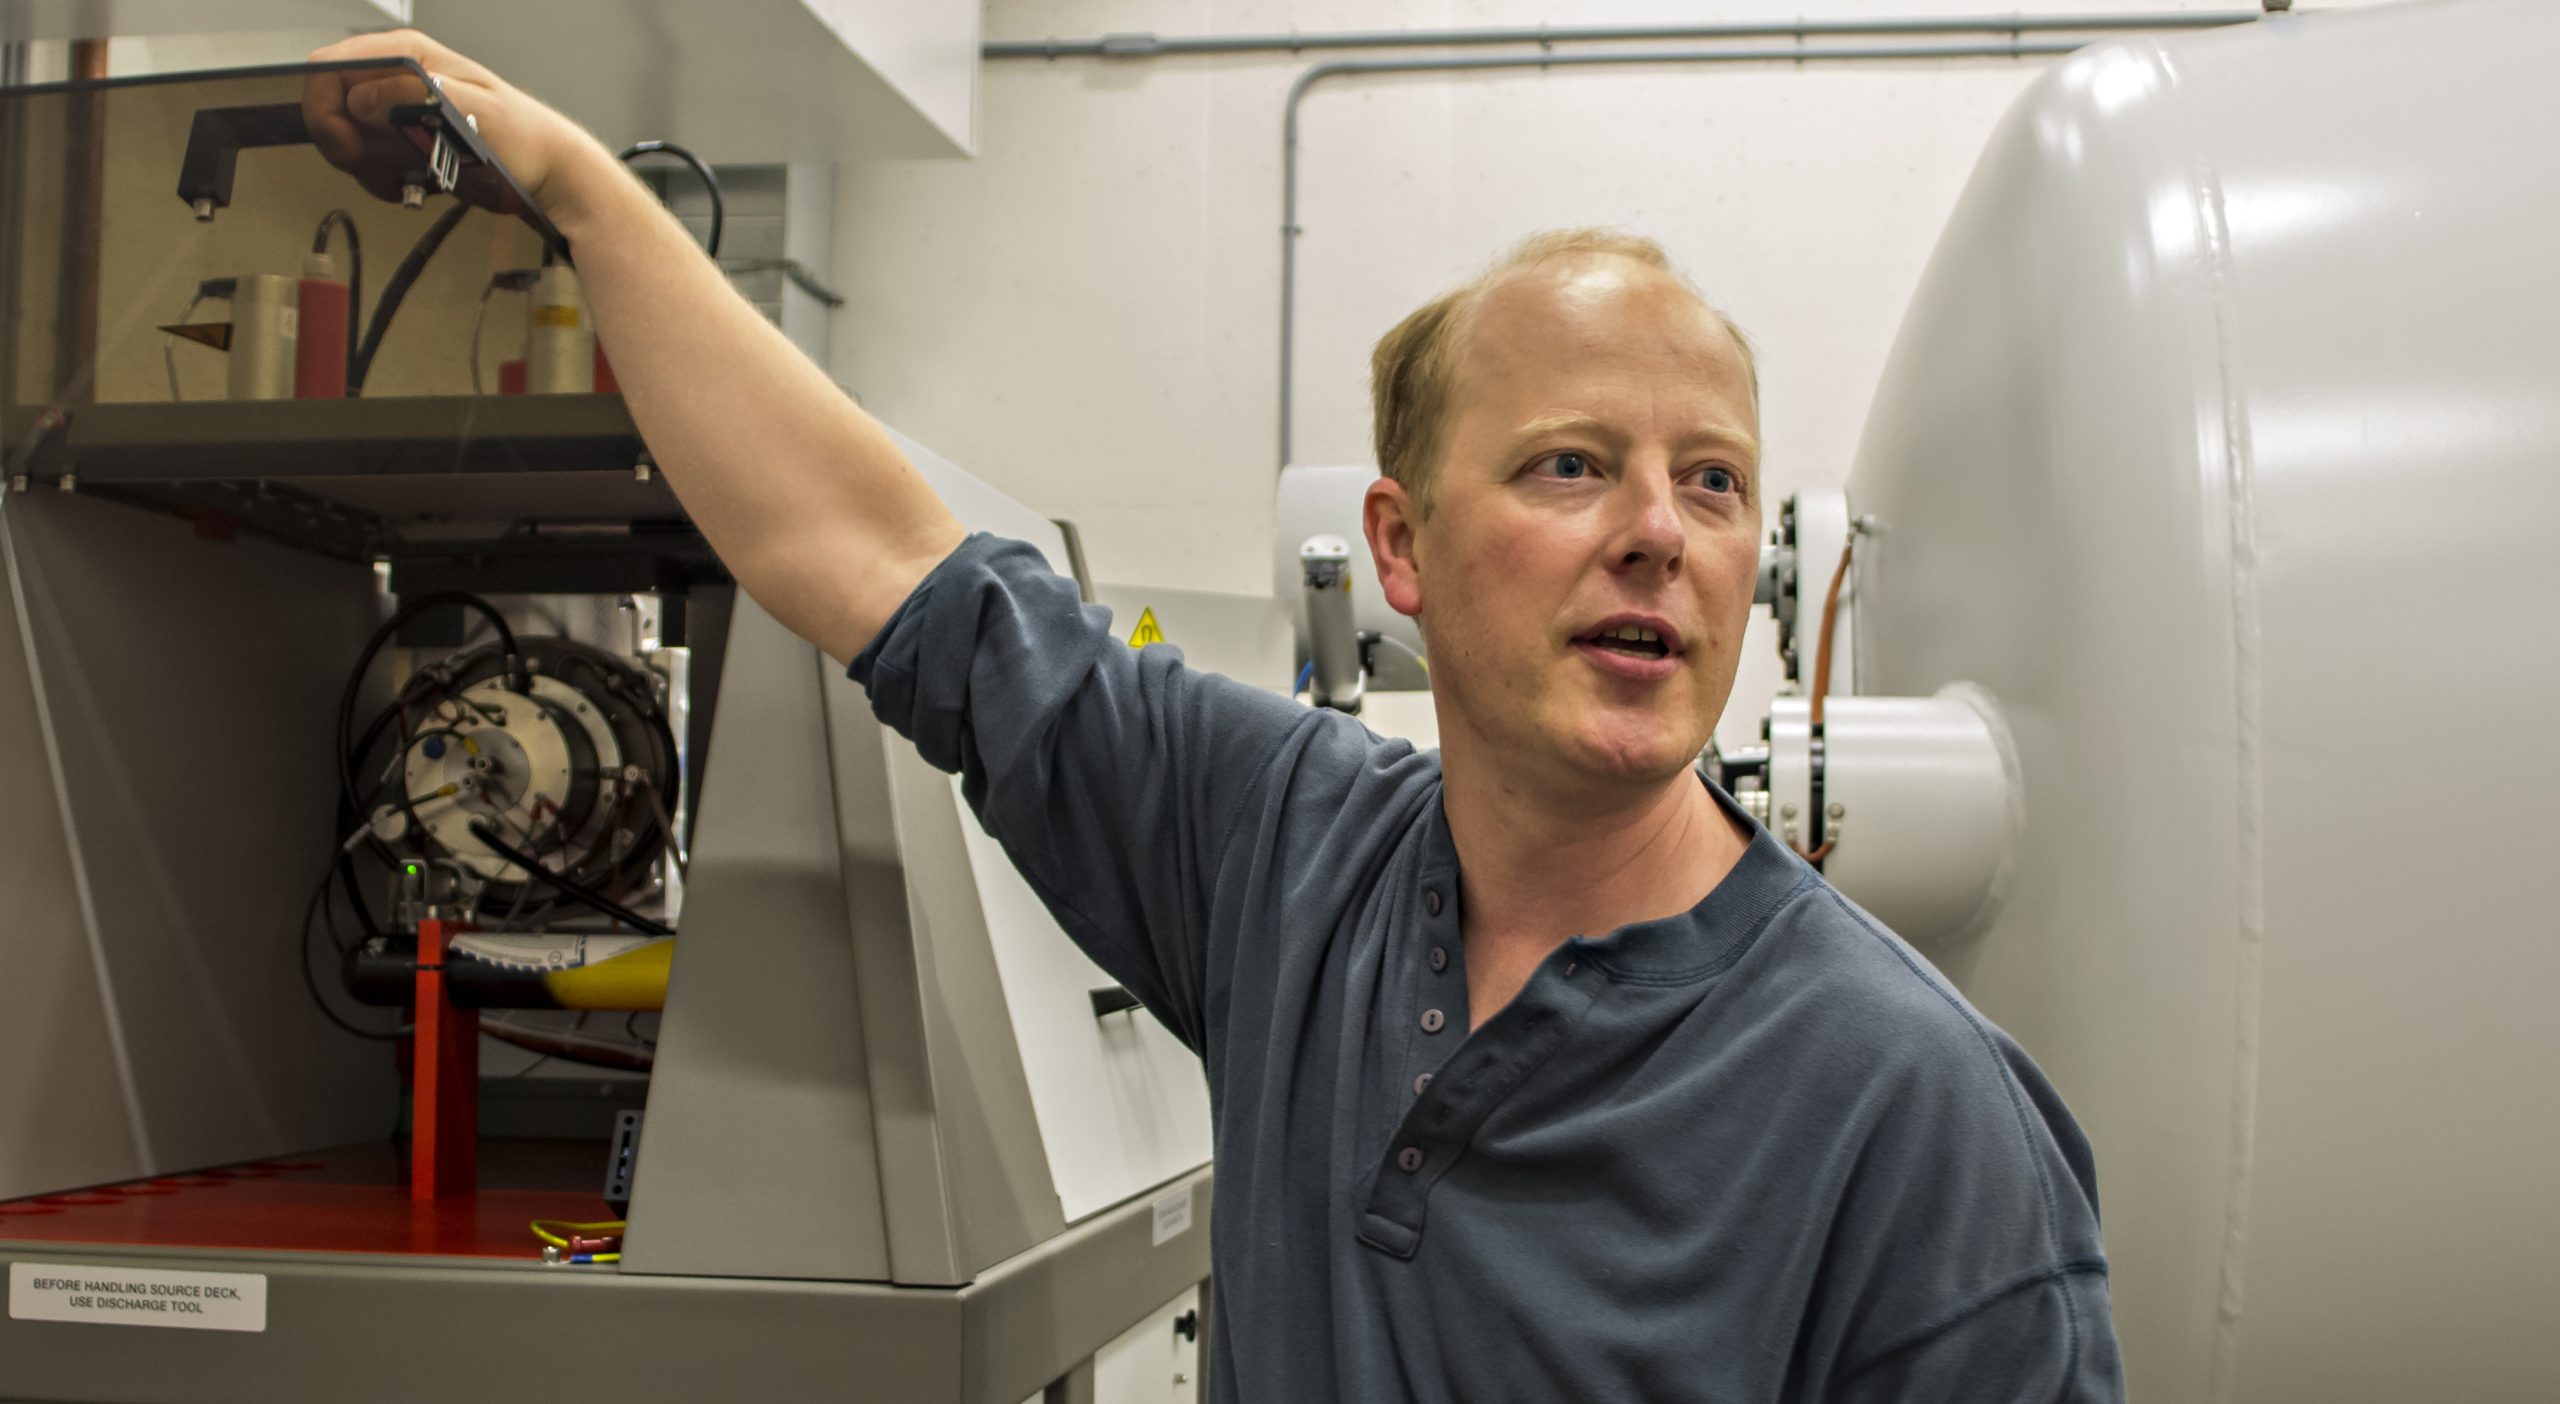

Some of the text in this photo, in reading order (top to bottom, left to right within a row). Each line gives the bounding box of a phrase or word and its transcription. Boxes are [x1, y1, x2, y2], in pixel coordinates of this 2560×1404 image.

[33, 1278, 242, 1300] BEFORE HANDLING SOURCE DECK,
[69, 1296, 204, 1313] USE DISCHARGE TOOL
